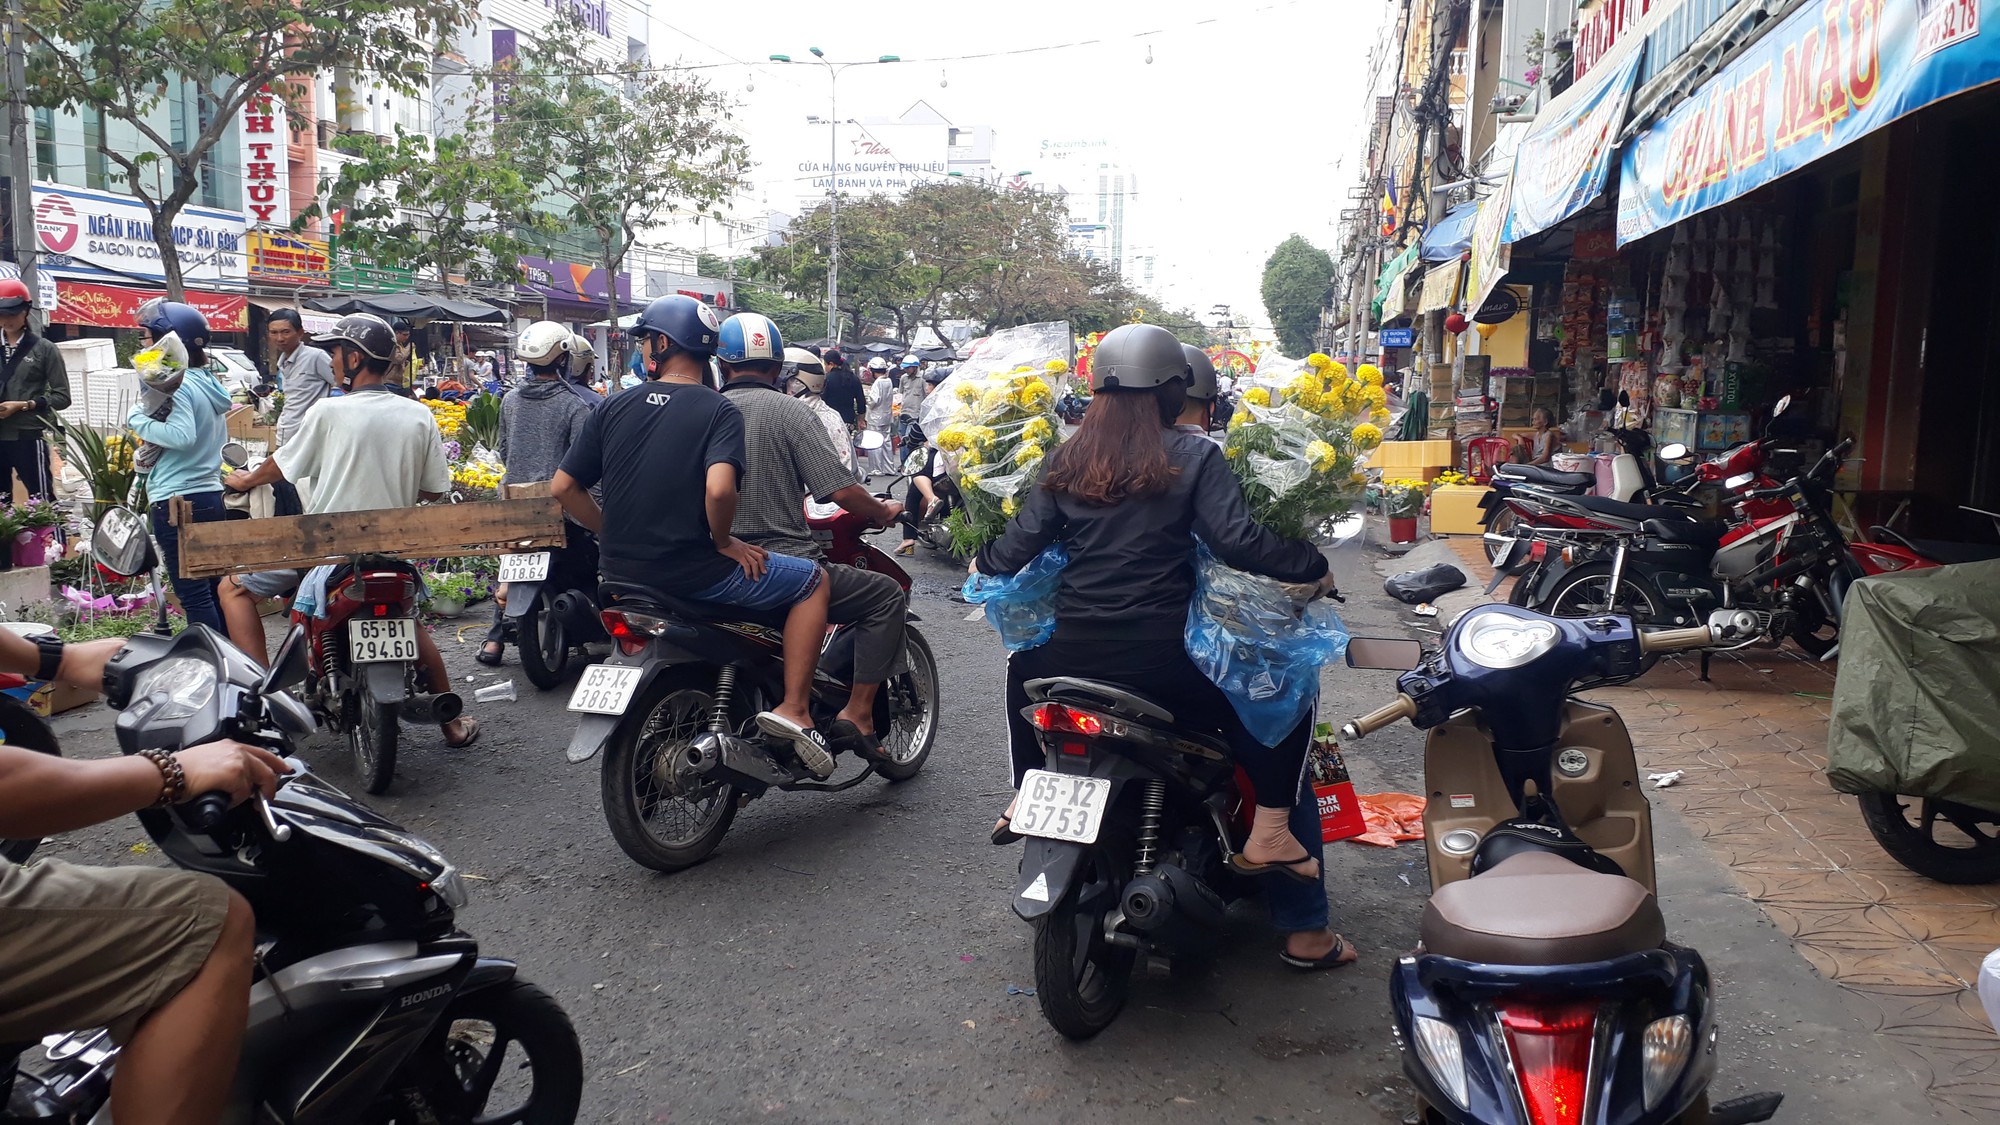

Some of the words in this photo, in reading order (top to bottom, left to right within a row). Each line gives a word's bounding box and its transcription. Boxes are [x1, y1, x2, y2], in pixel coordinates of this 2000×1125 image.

[37, 224, 62, 233] BANK
[88, 213, 123, 238] NGÂN
[45, 254, 72, 265] SCB
[88, 240, 134, 257] SAIGON
[210, 254, 238, 268] BANK
[1727, 372, 1737, 404] XYLITOL
[502, 567, 544, 580] 018.64
[361, 620, 405, 638] 65-B1
[355, 640, 414, 660] 294.60
[577, 689, 622, 710] 3863
[1024, 803, 1089, 836] 5753
[400, 983, 453, 1008] HONDA
